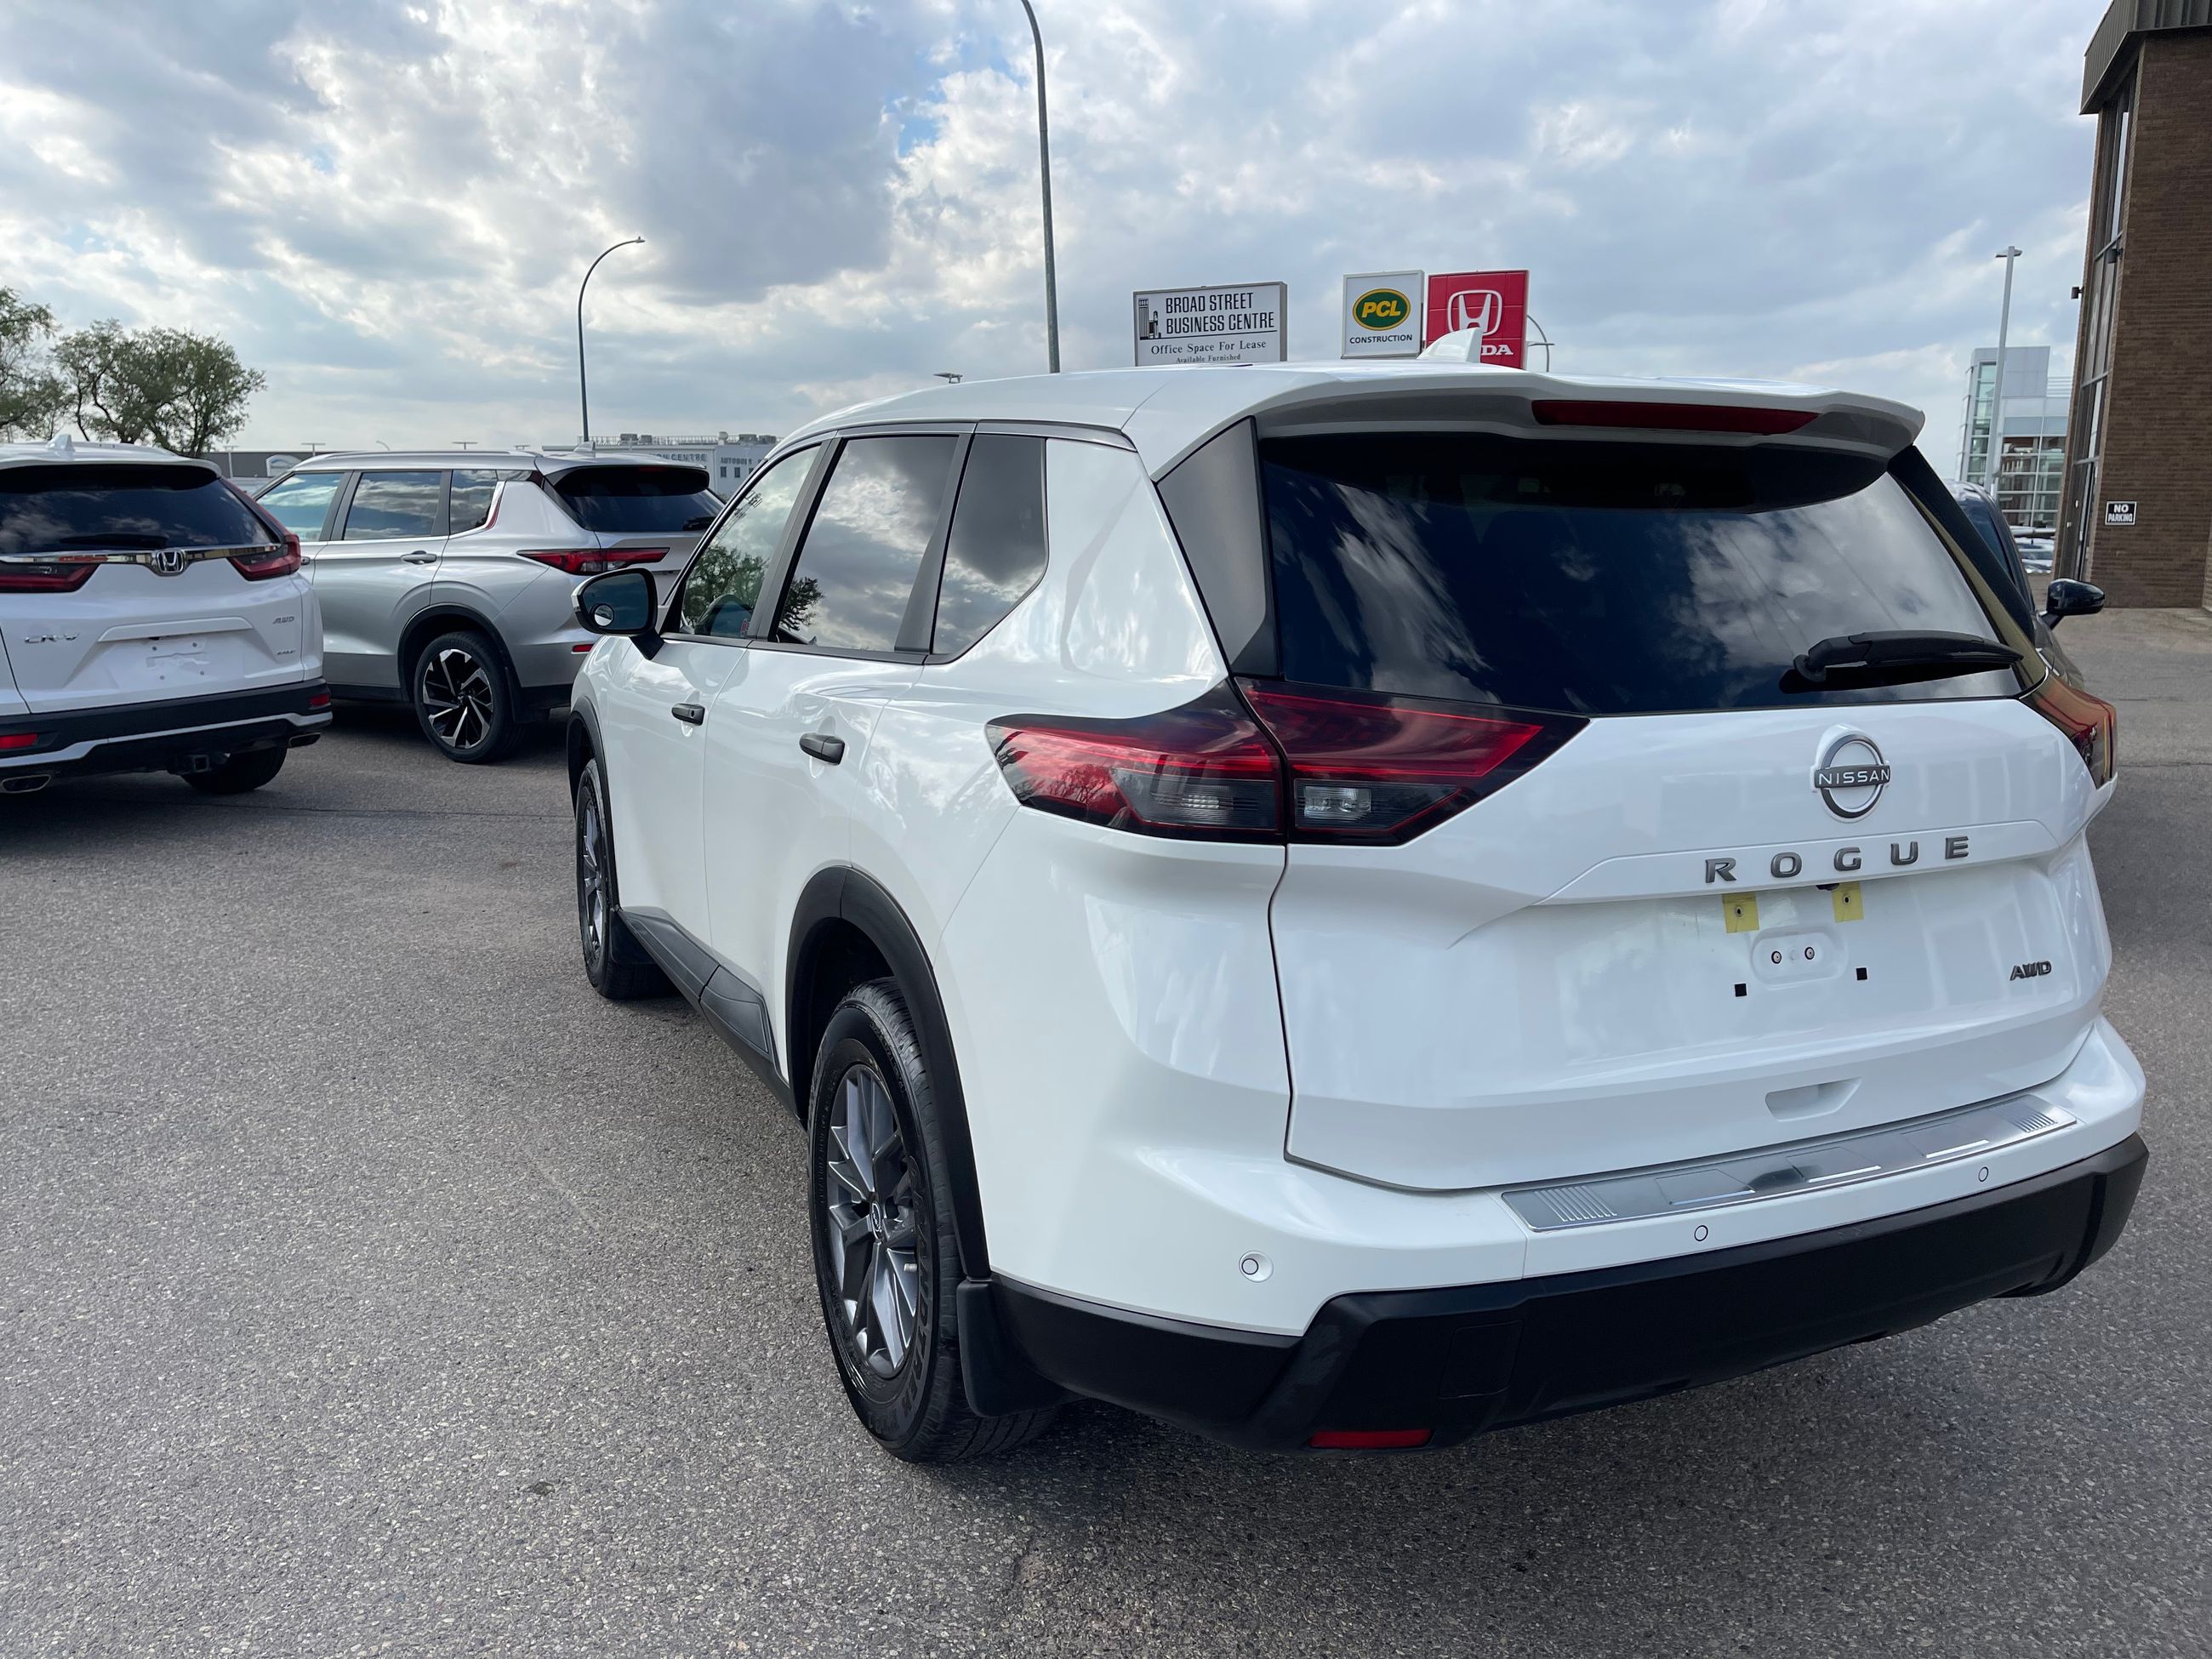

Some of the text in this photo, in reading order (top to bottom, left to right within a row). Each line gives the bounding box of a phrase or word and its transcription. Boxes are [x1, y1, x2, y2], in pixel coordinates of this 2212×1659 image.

[1166, 293, 1254, 314] BROAD STREET
[1361, 300, 1401, 318] PCL
[1166, 311, 1274, 334] BUSINESS CENTRE
[1151, 340, 1267, 355] Office Space For Lease
[1349, 334, 1413, 345] CONSTRUCTION
[2113, 504, 2129, 513] NO
[2107, 513, 2133, 522] PARKING
[272, 616, 295, 624] AWD
[1818, 768, 1890, 785] NISSAN
[1704, 835, 1970, 884] ROGUE
[2010, 961, 2052, 982] AWD
